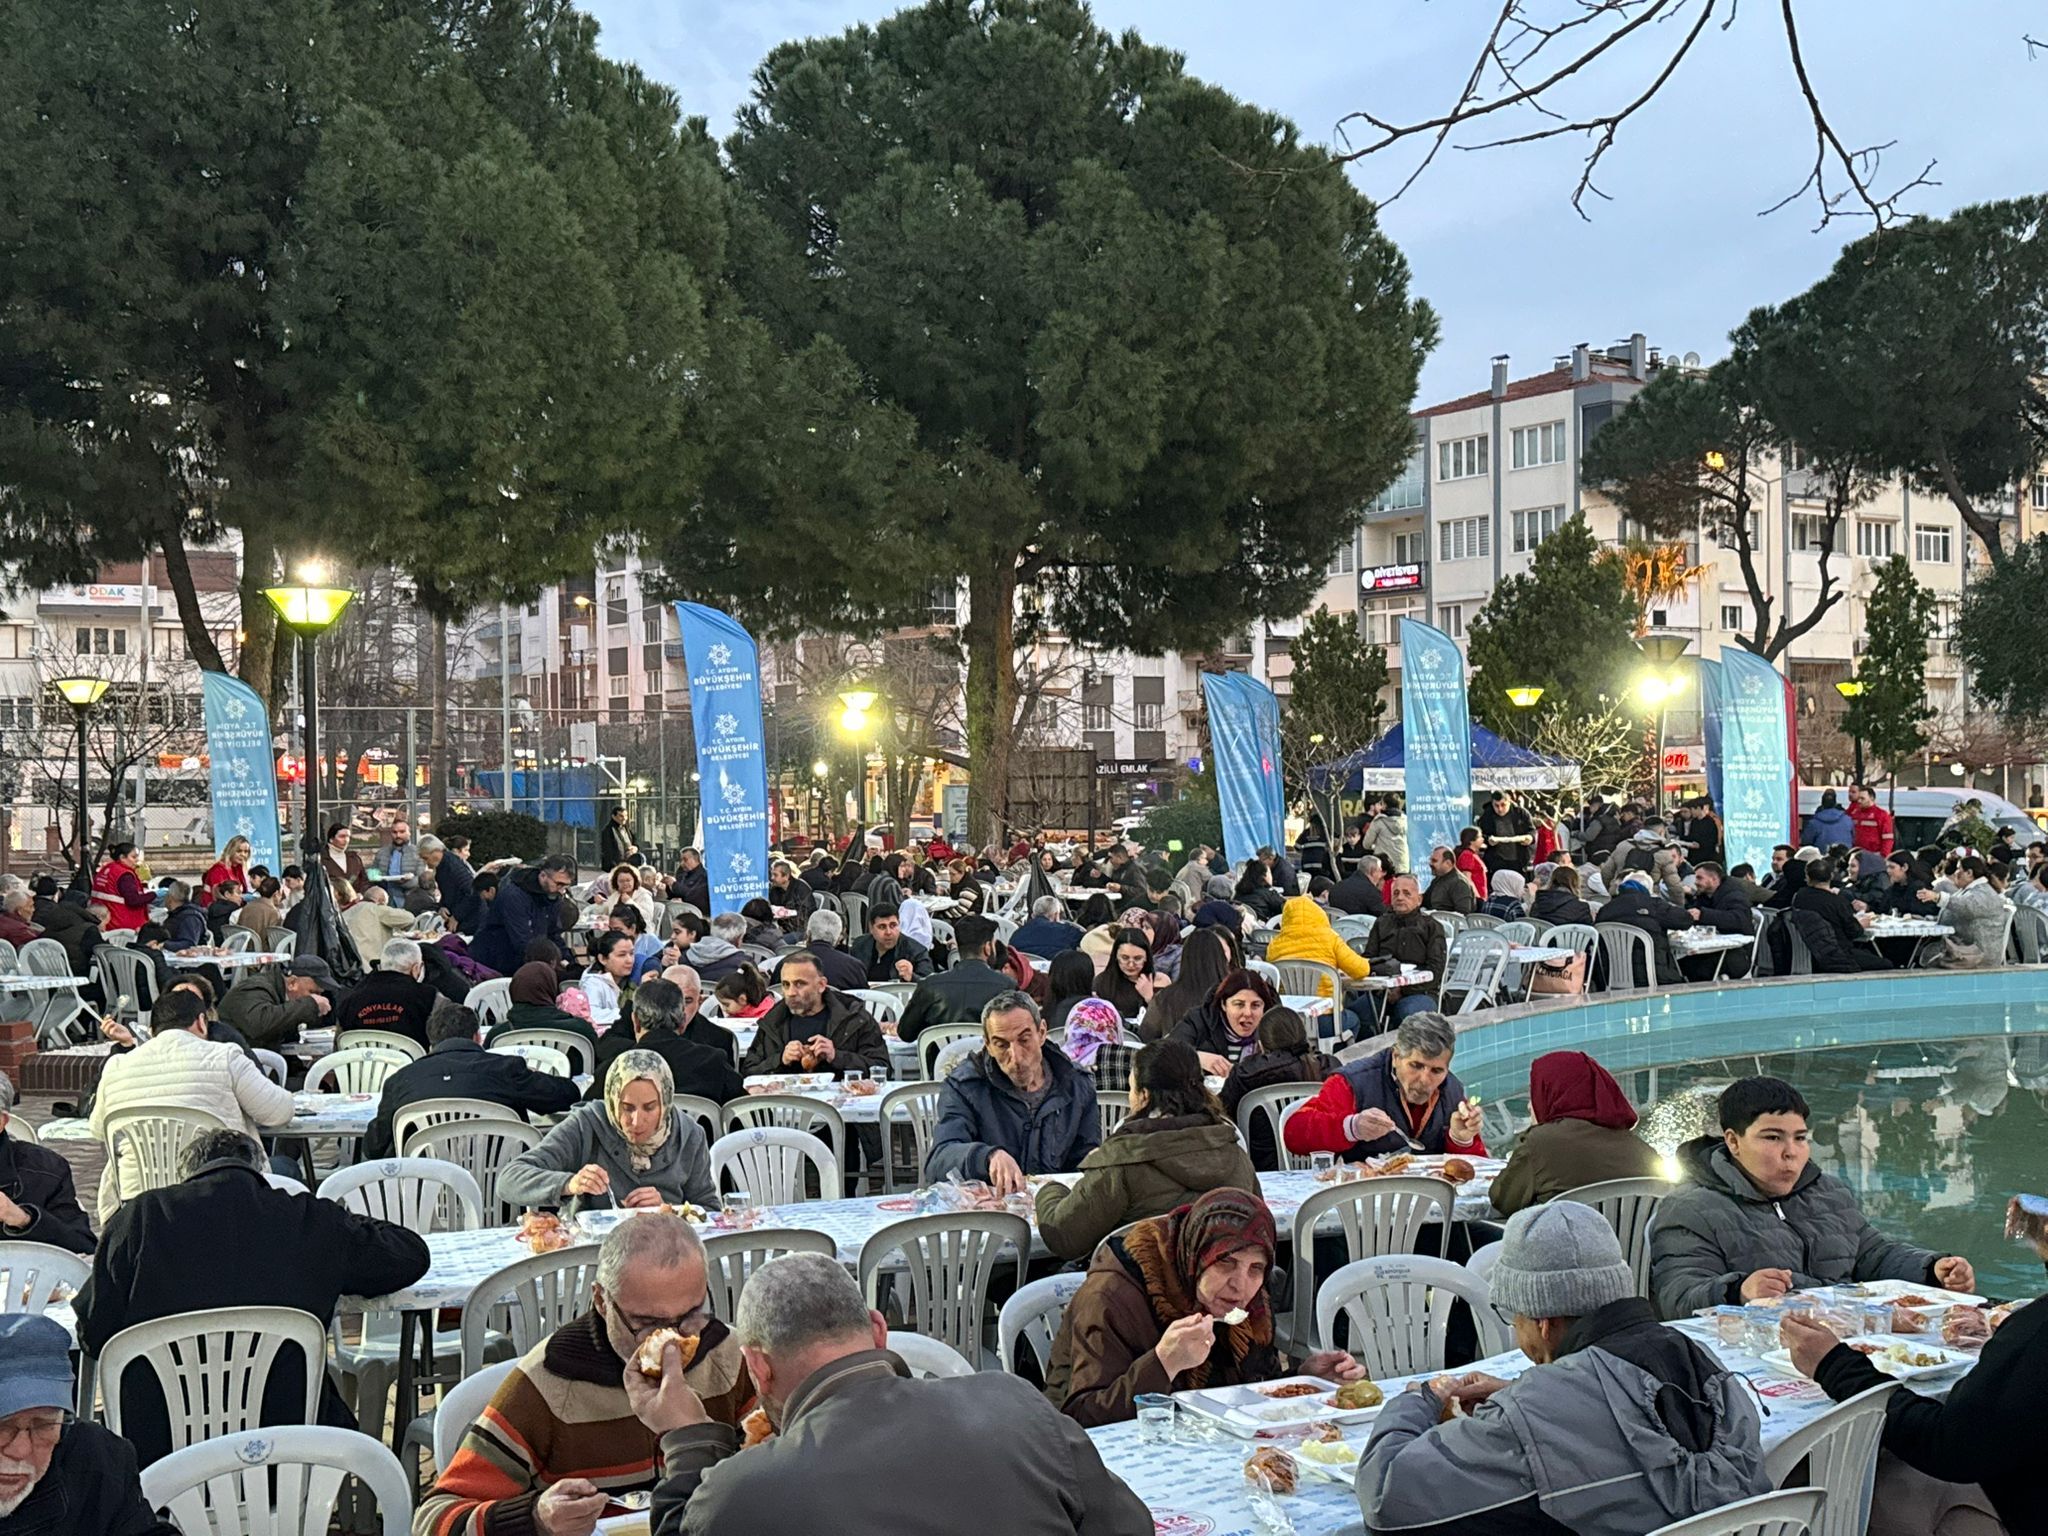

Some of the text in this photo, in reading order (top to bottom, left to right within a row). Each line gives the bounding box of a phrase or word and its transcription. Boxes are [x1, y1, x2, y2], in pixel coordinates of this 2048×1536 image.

[89, 586, 125, 597] ODAK
[693, 672, 752, 685] BÜYÜKŞEHİR
[701, 742, 759, 755] BÜYÜKŞEHİR
[1120, 764, 1148, 774] EMLAK
[707, 811, 766, 825] BÜYÜKŞEHİR
